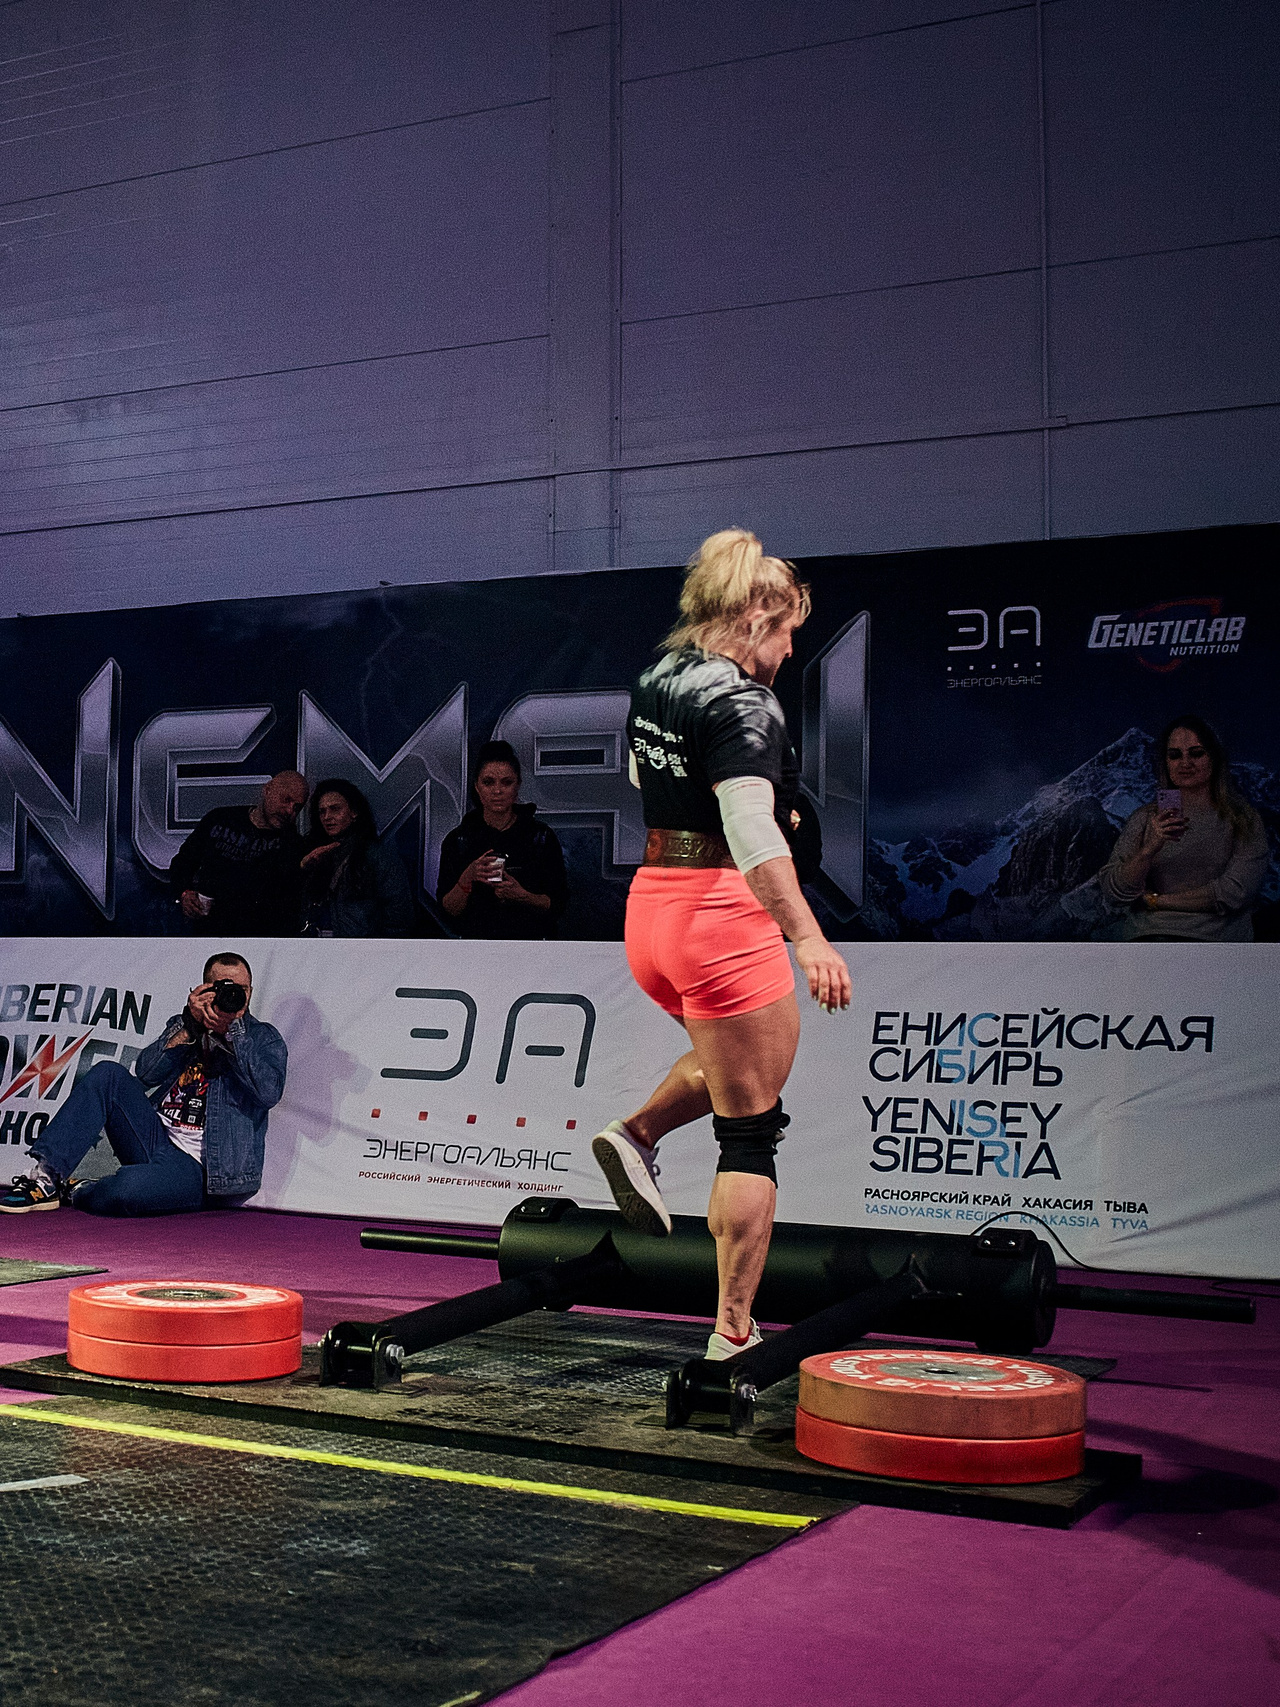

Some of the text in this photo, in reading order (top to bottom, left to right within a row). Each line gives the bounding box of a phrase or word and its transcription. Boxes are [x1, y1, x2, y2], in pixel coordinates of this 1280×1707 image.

[1087, 613, 1246, 649] GENETICLAB
[1169, 643, 1240, 657] NUTRITION
[946, 674, 1042, 689] ЭНЕРГОАЛЬЯНС
[871, 1007, 1215, 1053] ЕНИСЕЙСКАЯ
[868, 1046, 1063, 1087] СИБИРЬ
[861, 1095, 1063, 1140] YENISEY
[363, 1138, 572, 1172] ЭНЕРГОАЛЬЯНС
[868, 1134, 1062, 1181] SIBERIA
[358, 1170, 564, 1193] РОССИЙСКИЙ ЭНЕРГЕТИЧЕСКИЙ ХОЛДИНГ
[955, 1209, 1009, 1223] REGION
[1111, 1217, 1149, 1231] TYVA
[972, 1192, 1012, 1207] КРАЙ
[1021, 1196, 1094, 1212] ХАКАСИЯ
[1103, 1200, 1149, 1215] ТЫВА
